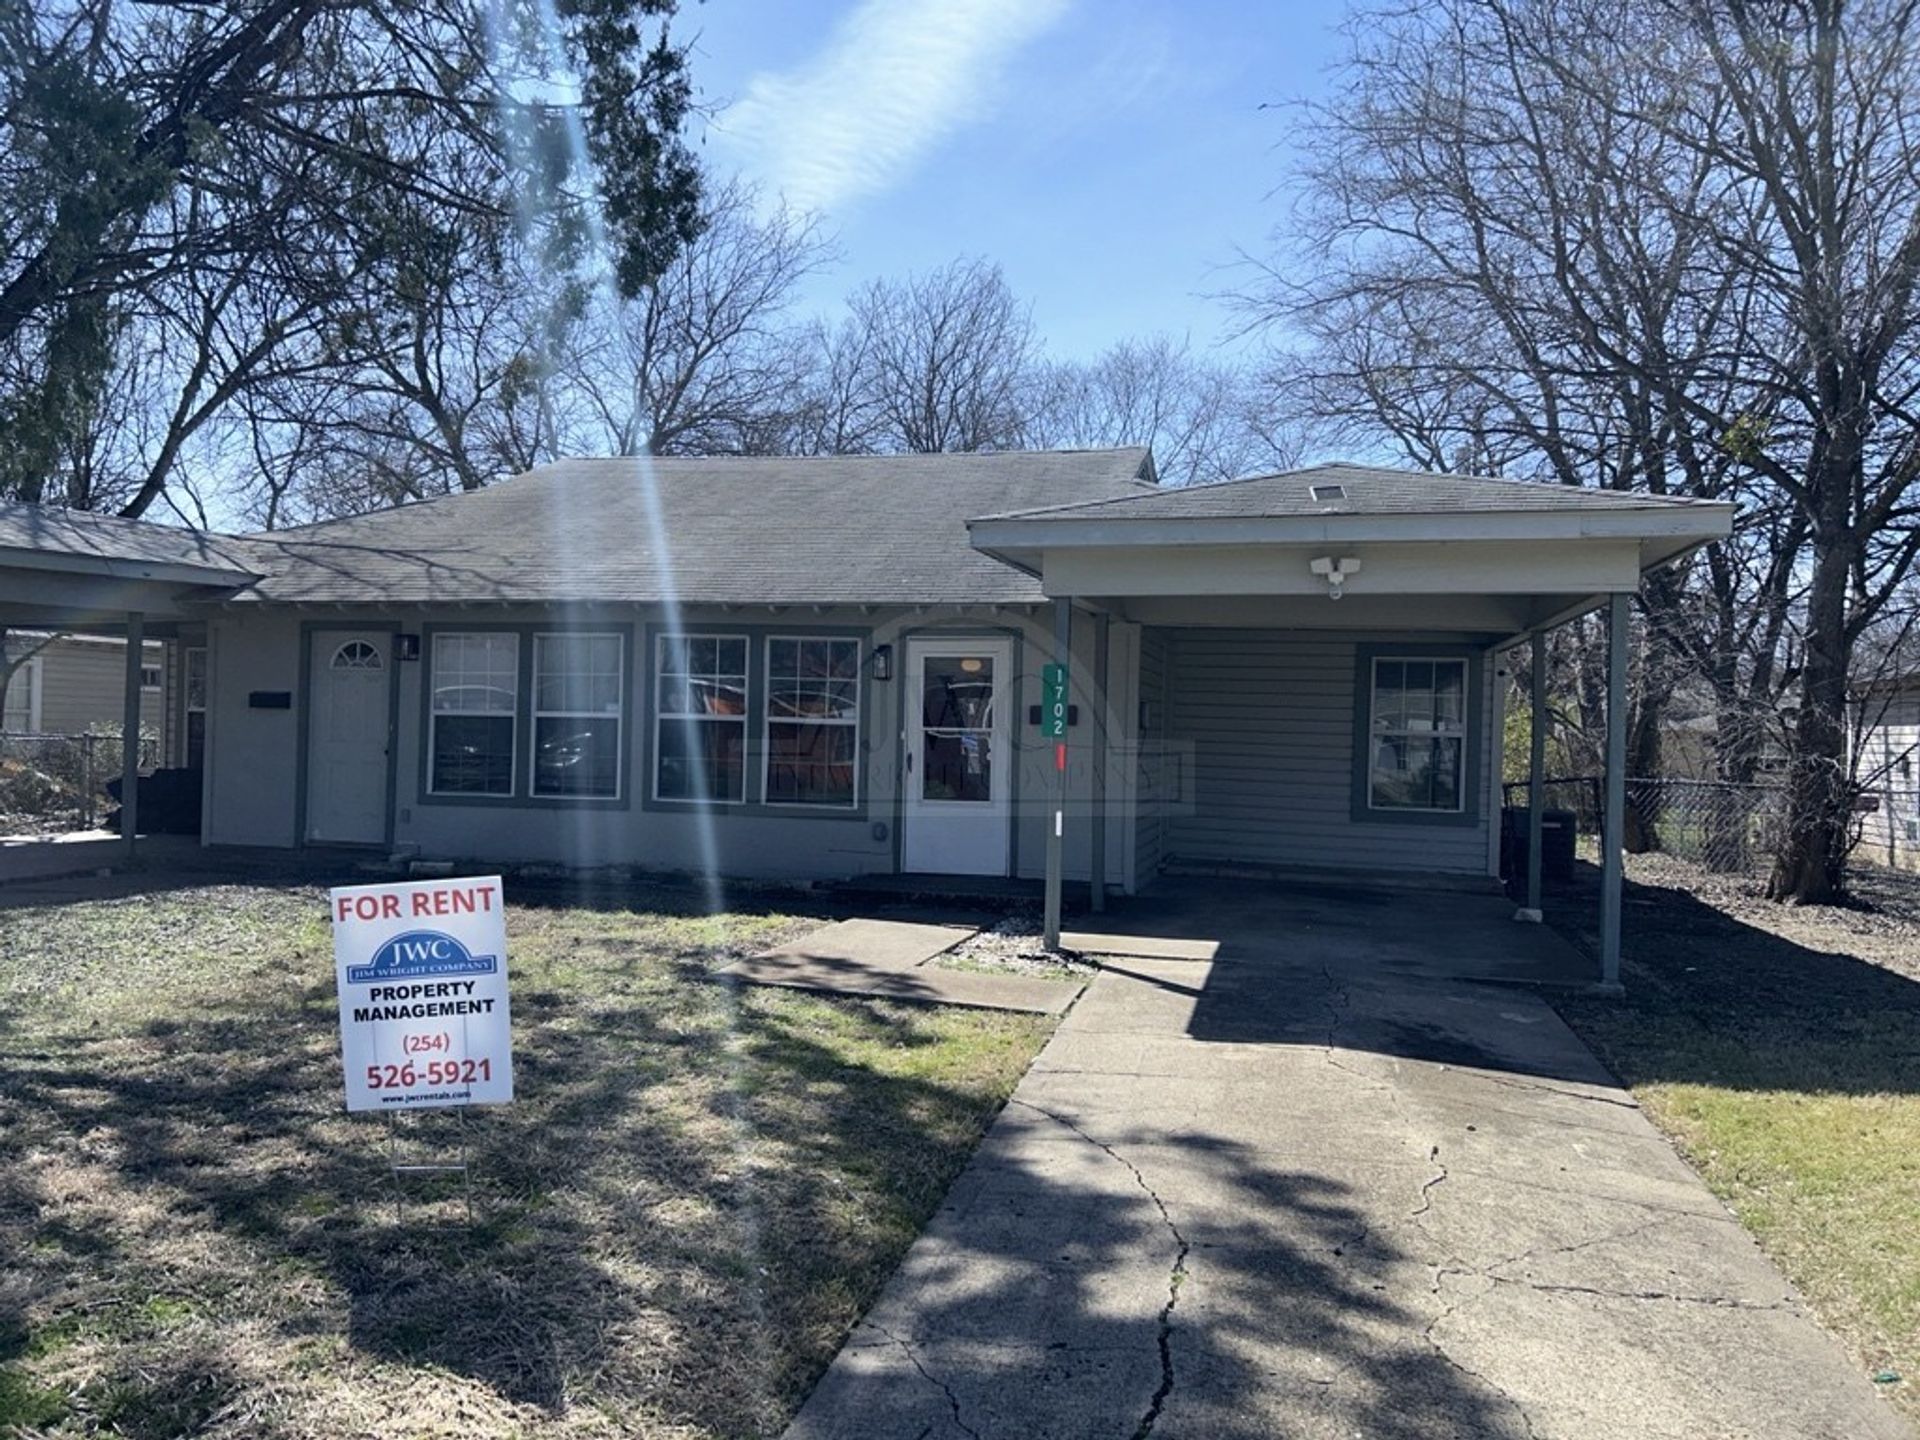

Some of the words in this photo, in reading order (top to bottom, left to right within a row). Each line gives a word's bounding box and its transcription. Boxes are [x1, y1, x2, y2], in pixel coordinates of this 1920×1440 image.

[1053, 668, 1064, 735] 1702
[338, 894, 402, 921] FOR
[412, 887, 495, 917] RENT
[389, 940, 452, 966] JWC
[353, 967, 375, 979] JIM
[377, 964, 428, 977] WRIGHT
[430, 961, 491, 974] COMPANY
[370, 981, 475, 1001] PROPERTY
[353, 999, 495, 1022] MANAGEMENT
[402, 1032, 450, 1055] (254)
[367, 1058, 491, 1089] 526-5921
[381, 1091, 472, 1104] www.jwcrentals.com
